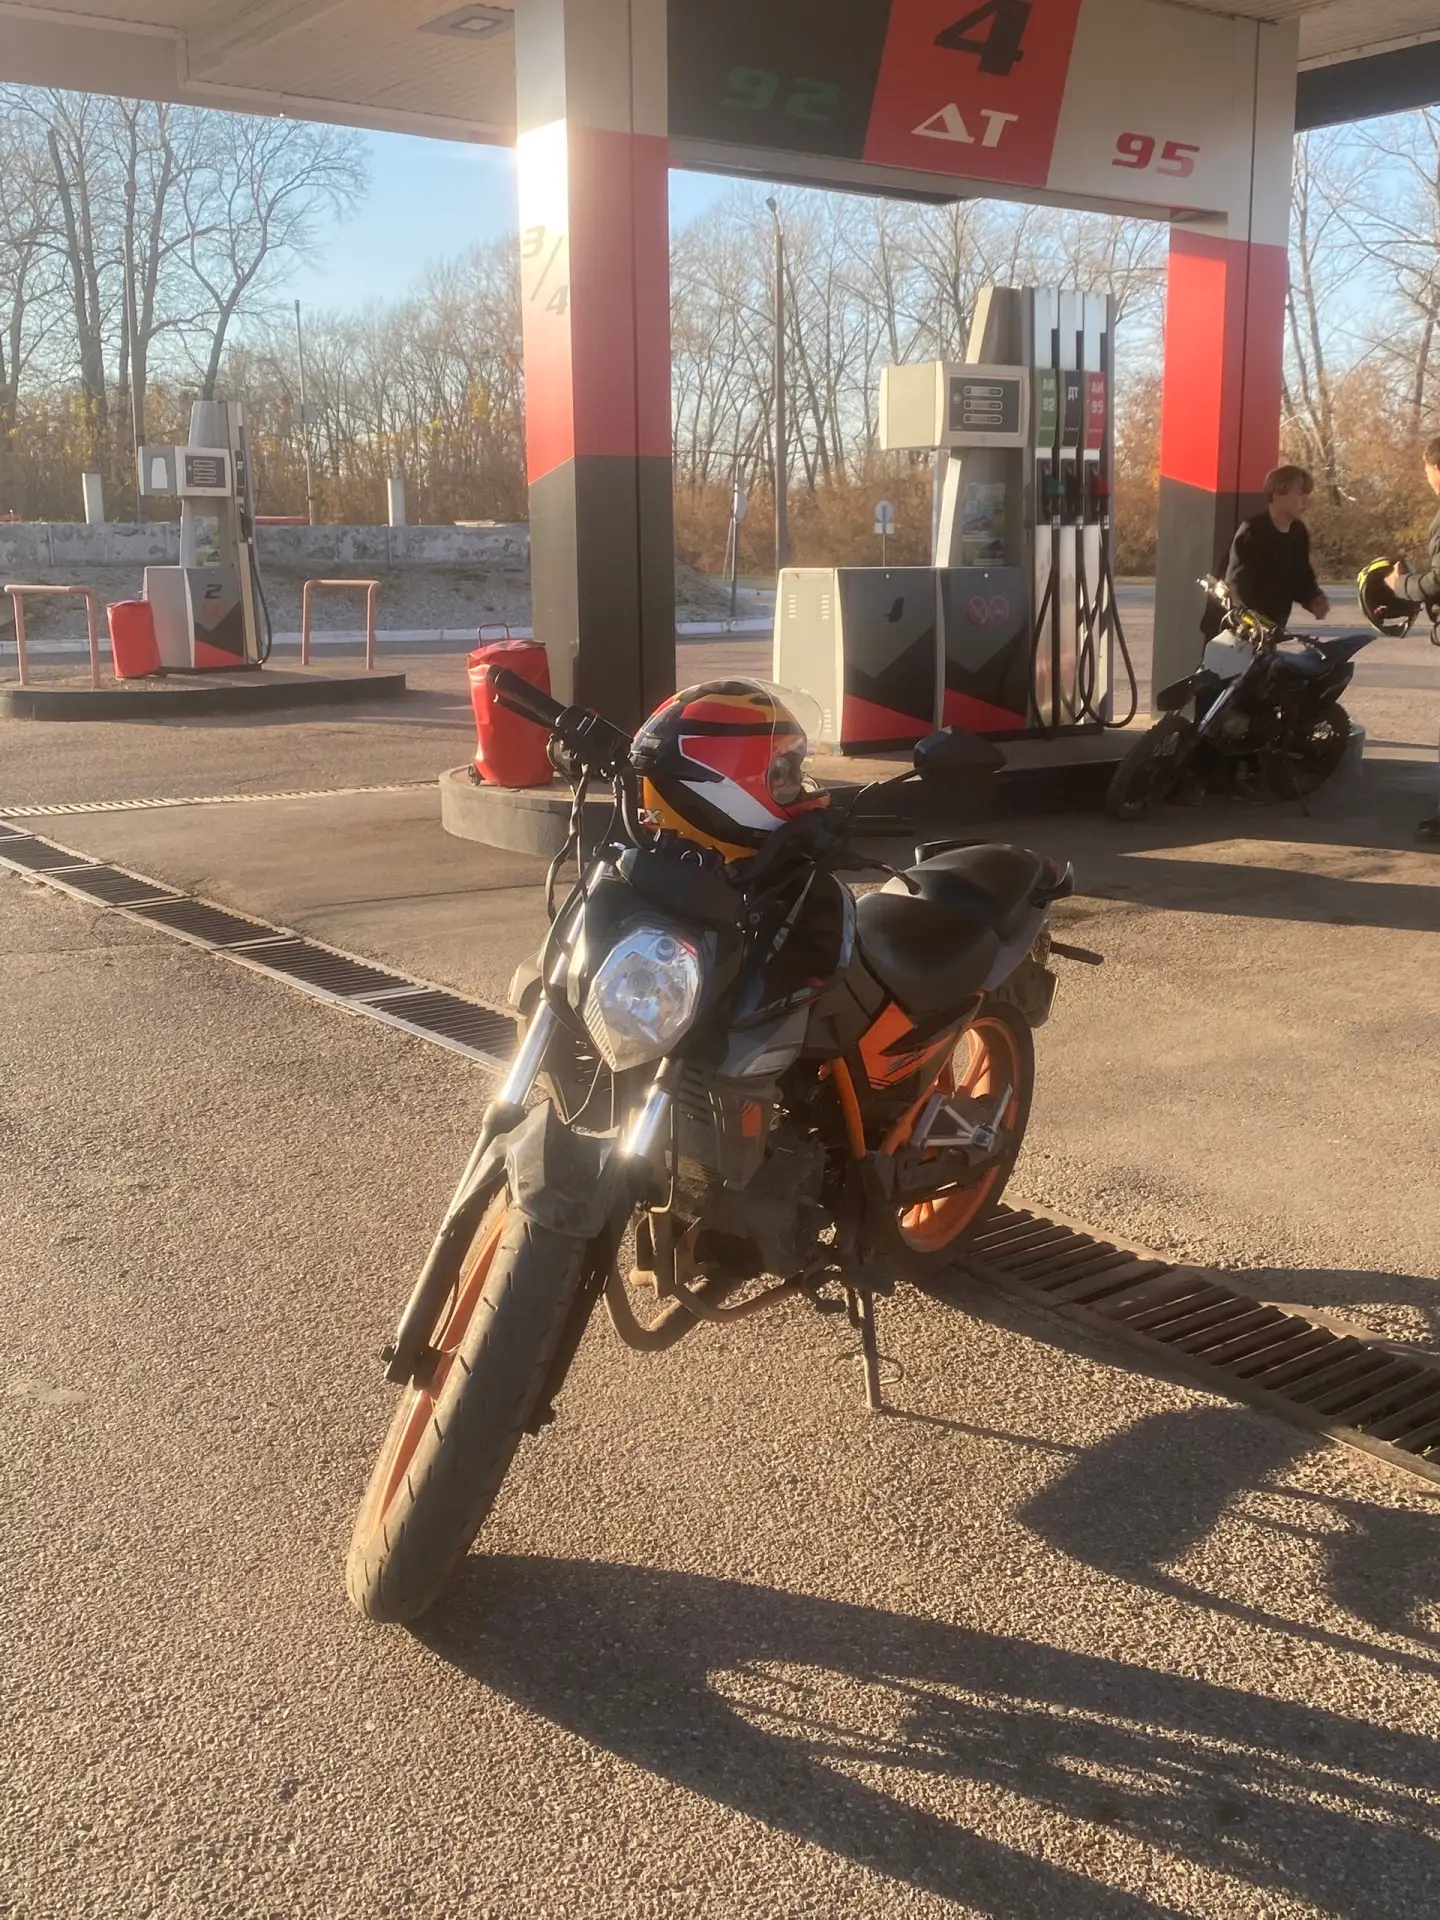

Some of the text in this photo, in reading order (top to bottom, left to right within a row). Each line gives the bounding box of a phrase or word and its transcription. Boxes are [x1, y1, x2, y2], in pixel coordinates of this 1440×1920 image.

[933, 0, 1032, 77] 4
[720, 66, 841, 122] 92
[910, 102, 1019, 147] ДТ
[1112, 132, 1200, 178] 95
[1042, 397, 1055, 412] 92
[1091, 400, 1104, 414] 95
[205, 584, 223, 599] 2
